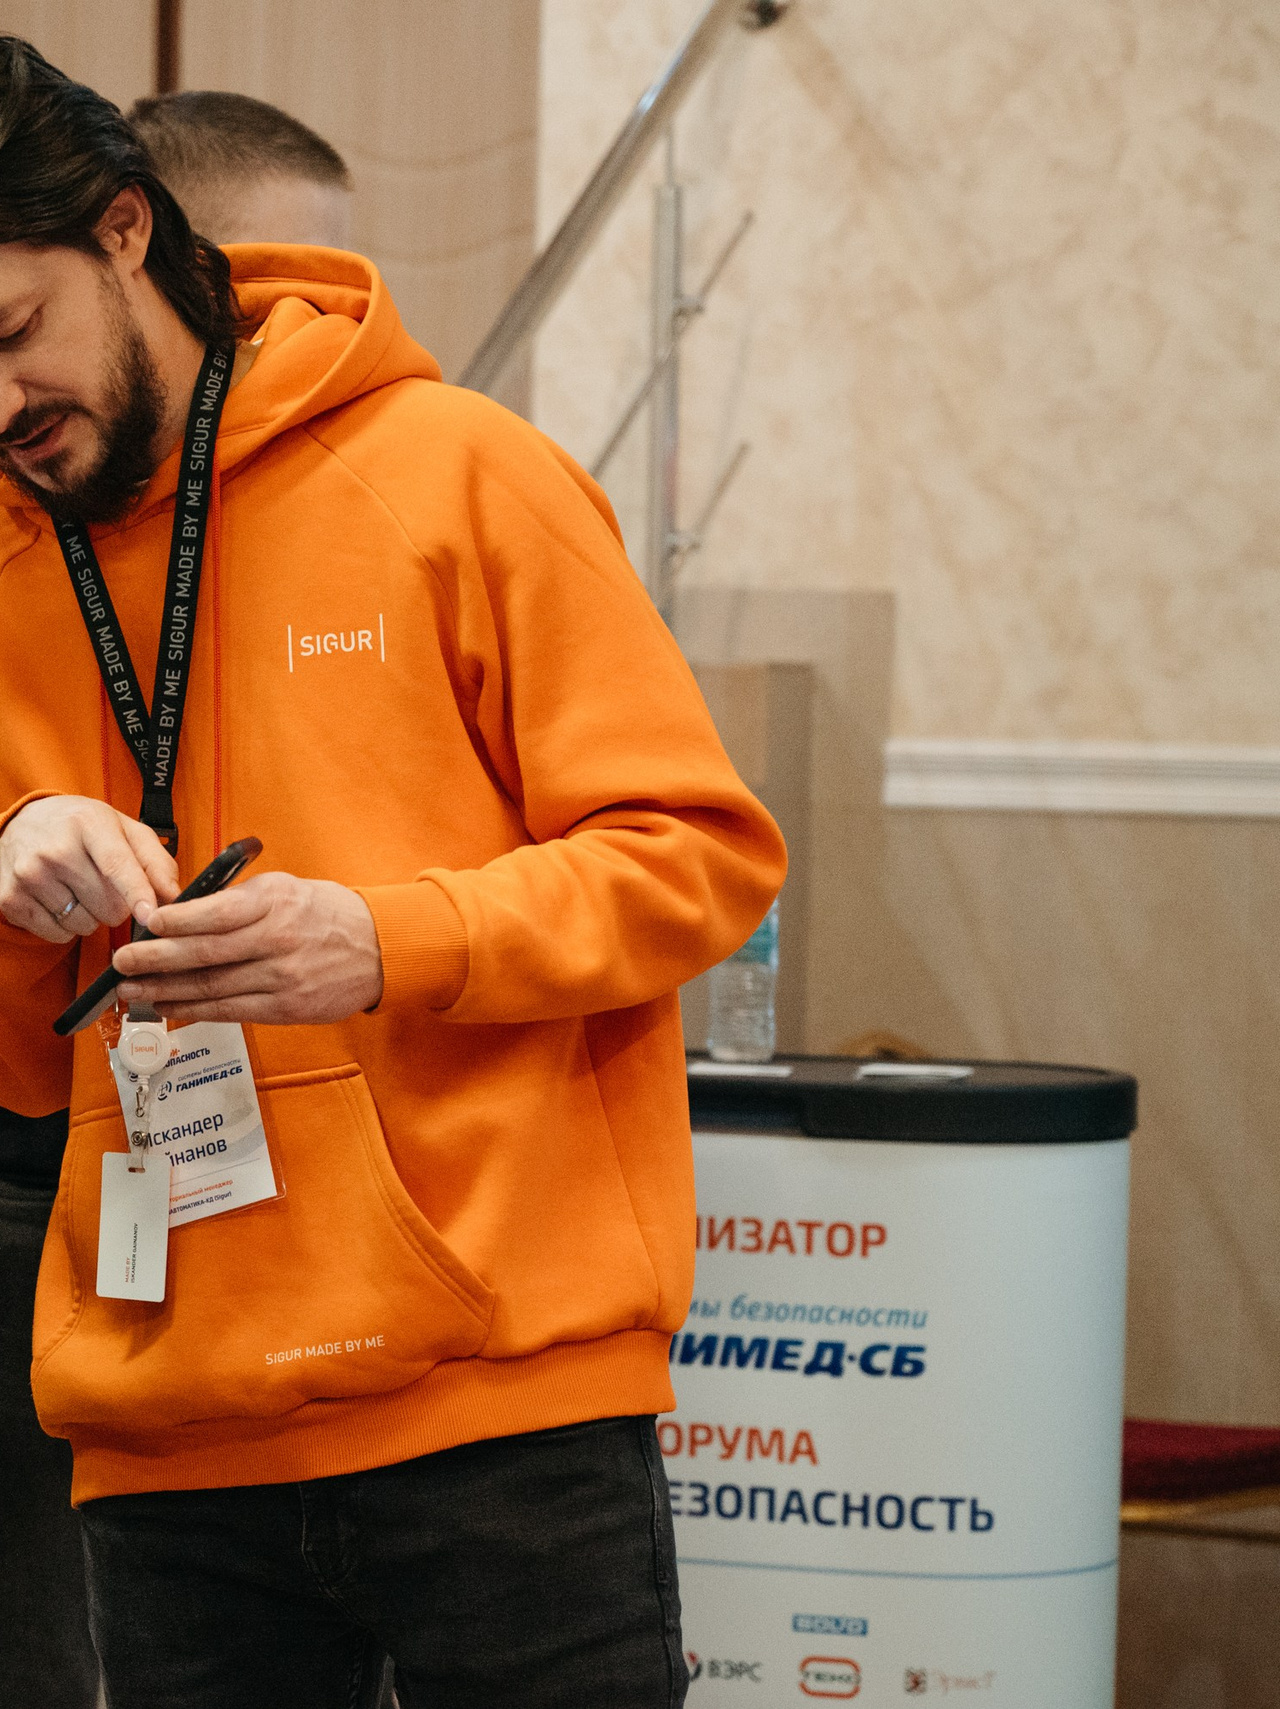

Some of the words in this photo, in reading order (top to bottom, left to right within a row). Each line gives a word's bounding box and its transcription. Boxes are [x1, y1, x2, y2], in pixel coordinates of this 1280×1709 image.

[213, 349, 228, 369] BY
[200, 369, 224, 411] MADE
[190, 417, 212, 471] SIGUR
[186, 479, 203, 506] ME
[182, 514, 199, 537] BY
[66, 535, 87, 564] ME
[175, 545, 196, 597] MADE
[78, 568, 106, 622] SIGUR
[168, 605, 189, 661] SIGUR
[300, 629, 373, 657] SIGUR
[96, 625, 125, 676] MADE
[113, 680, 134, 701] BY
[164, 669, 181, 695] ME
[123, 709, 144, 735] ME
[159, 703, 177, 728] BY
[154, 735, 172, 787] MADE
[134, 1045, 154, 1053] SIGUR
[696, 1215, 888, 1259] ИЗАТОР
[730, 1293, 928, 1330] безопасности
[265, 1348, 302, 1365] SIGUR
[306, 1342, 342, 1357] MADE
[345, 1339, 362, 1352] BY
[365, 1335, 386, 1349] ME
[669, 1332, 927, 1378] ИМЕД·СБ
[657, 1420, 818, 1466] ОРУМА
